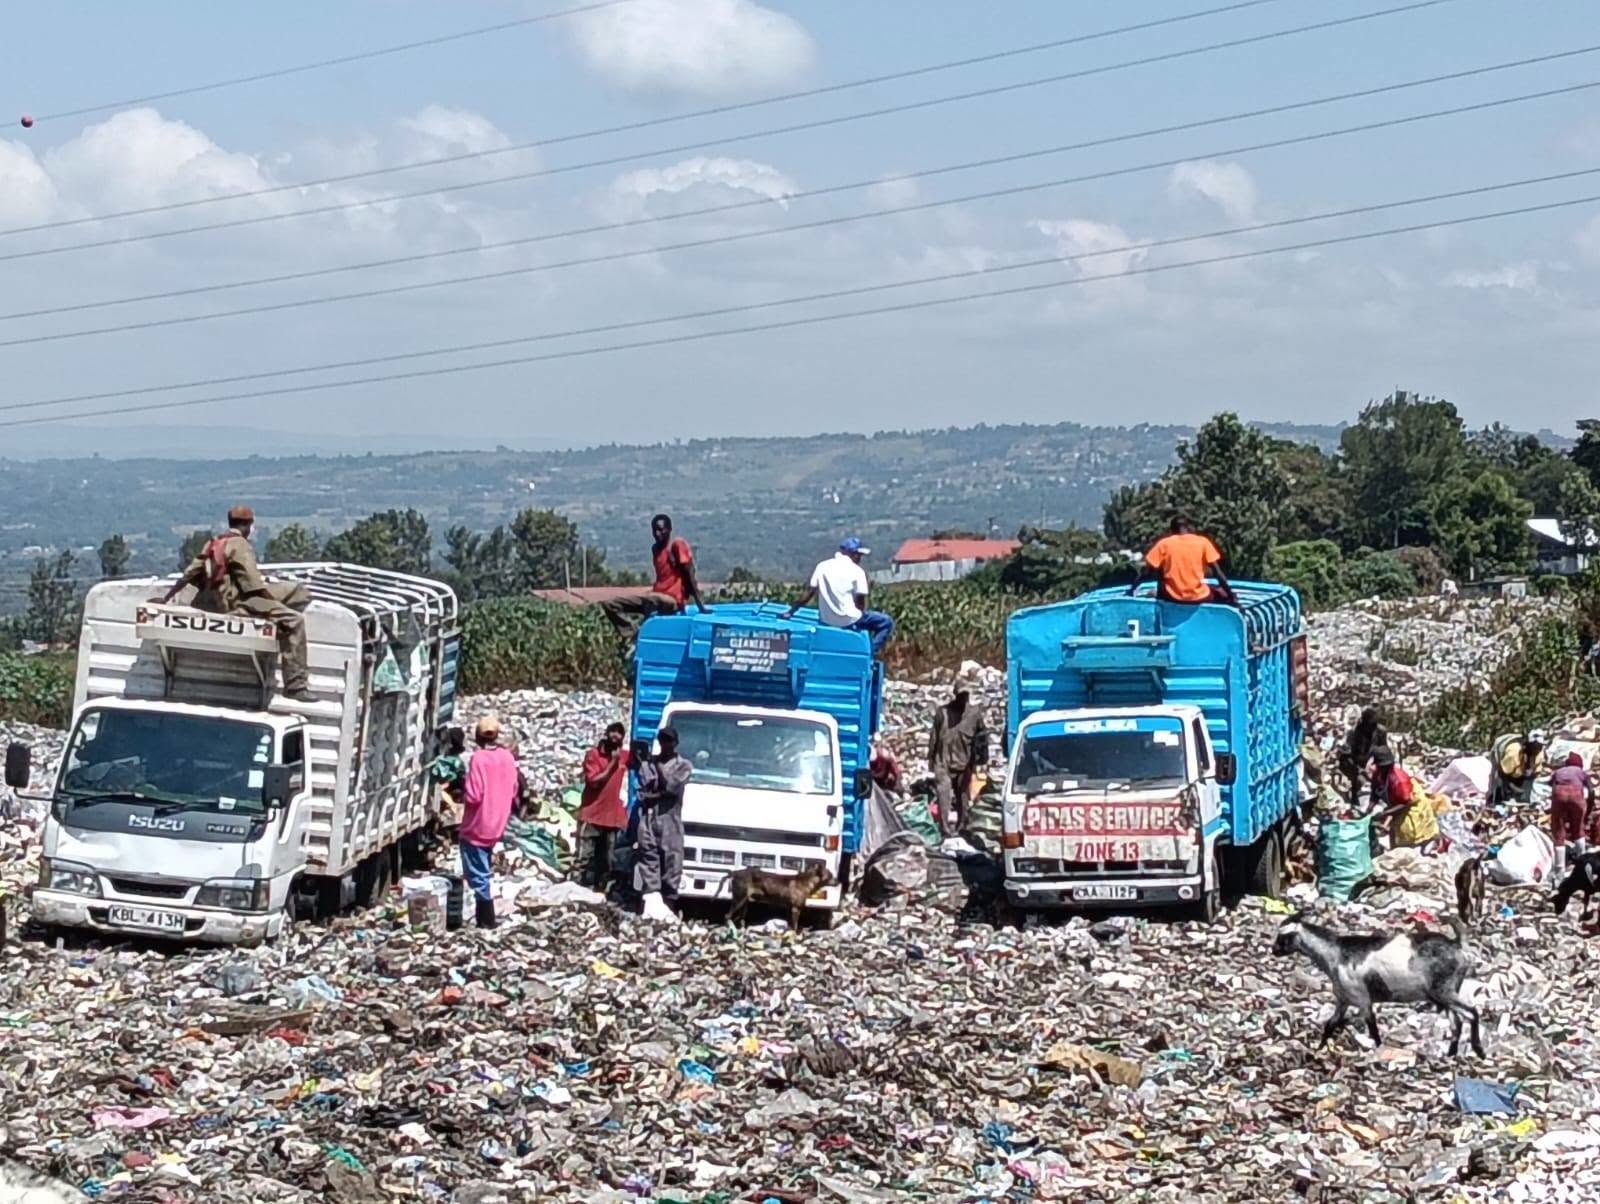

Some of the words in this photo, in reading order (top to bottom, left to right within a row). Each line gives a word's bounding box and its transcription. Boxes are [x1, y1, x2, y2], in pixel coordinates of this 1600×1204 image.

[164, 614, 244, 635] ISUZU
[128, 814, 185, 831] ISUZU
[1075, 842, 1117, 861] ZONE
[1121, 842, 1140, 861] 13
[112, 908, 140, 923] KBL
[147, 912, 183, 928] 413H
